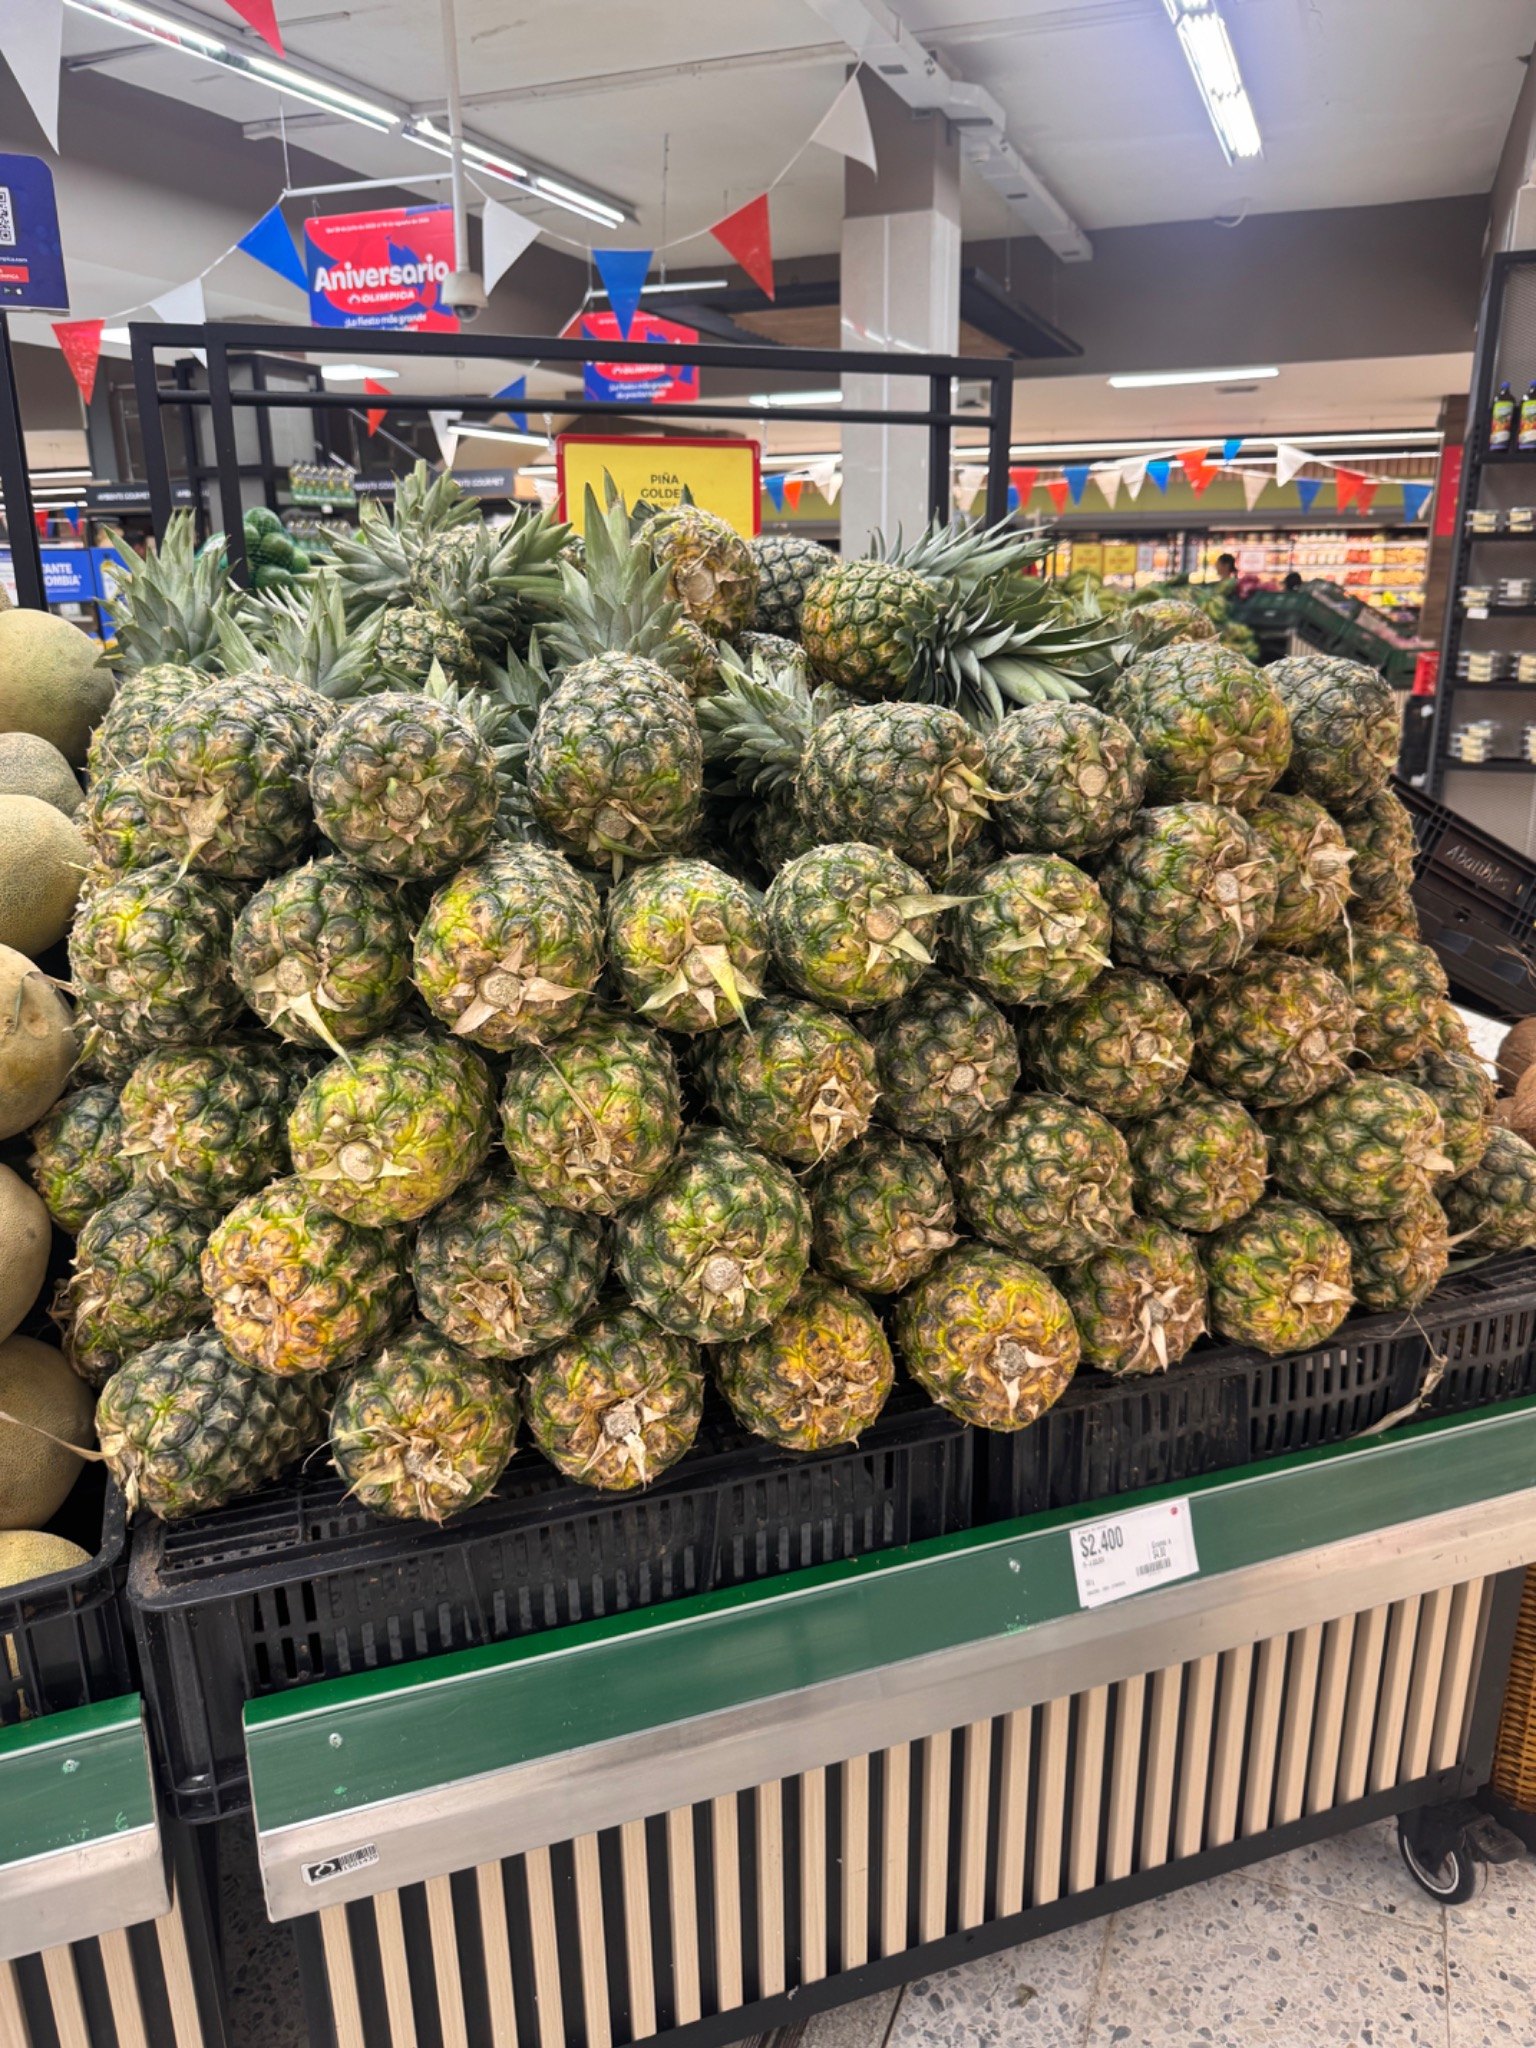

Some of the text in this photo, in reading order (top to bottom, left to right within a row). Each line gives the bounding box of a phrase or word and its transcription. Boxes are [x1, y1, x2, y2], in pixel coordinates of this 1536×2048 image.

[314, 254, 449, 292] Aniversario
[360, 290, 415, 304] OLIMPICA
[650, 472, 679, 484] PIÑA
[640, 488, 683, 499] GOLDE
[1079, 1525, 1124, 1558] $2.400
